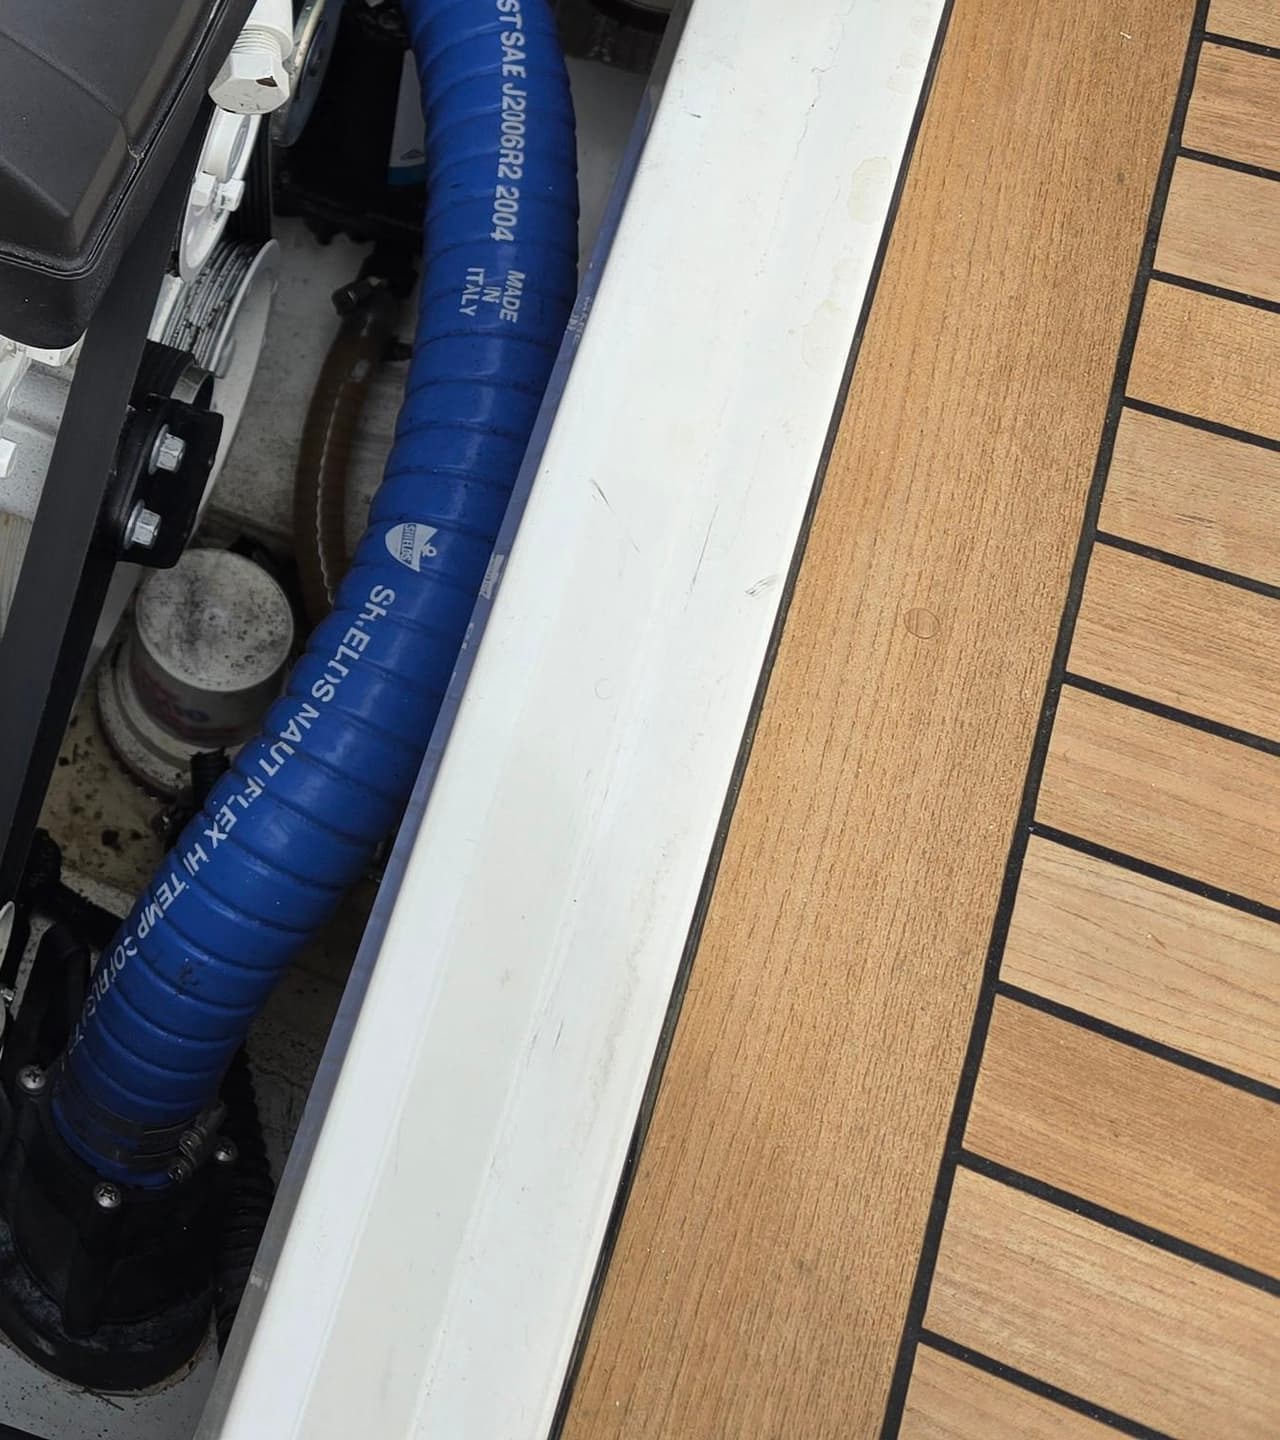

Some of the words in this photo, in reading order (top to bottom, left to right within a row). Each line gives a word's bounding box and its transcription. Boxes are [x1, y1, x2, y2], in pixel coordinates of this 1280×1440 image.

[500, 31, 526, 78] SAE
[498, 83, 526, 180] J2006R2
[490, 185, 519, 242] 2004
[459, 267, 484, 316] ITALY
[483, 286, 501, 303] IN
[499, 269, 526, 323] MADE
[399, 523, 417, 565] SHIELDS
[312, 585, 395, 702] SHELDS
[182, 843, 209, 877] HI
[137, 873, 188, 939] TEMP
